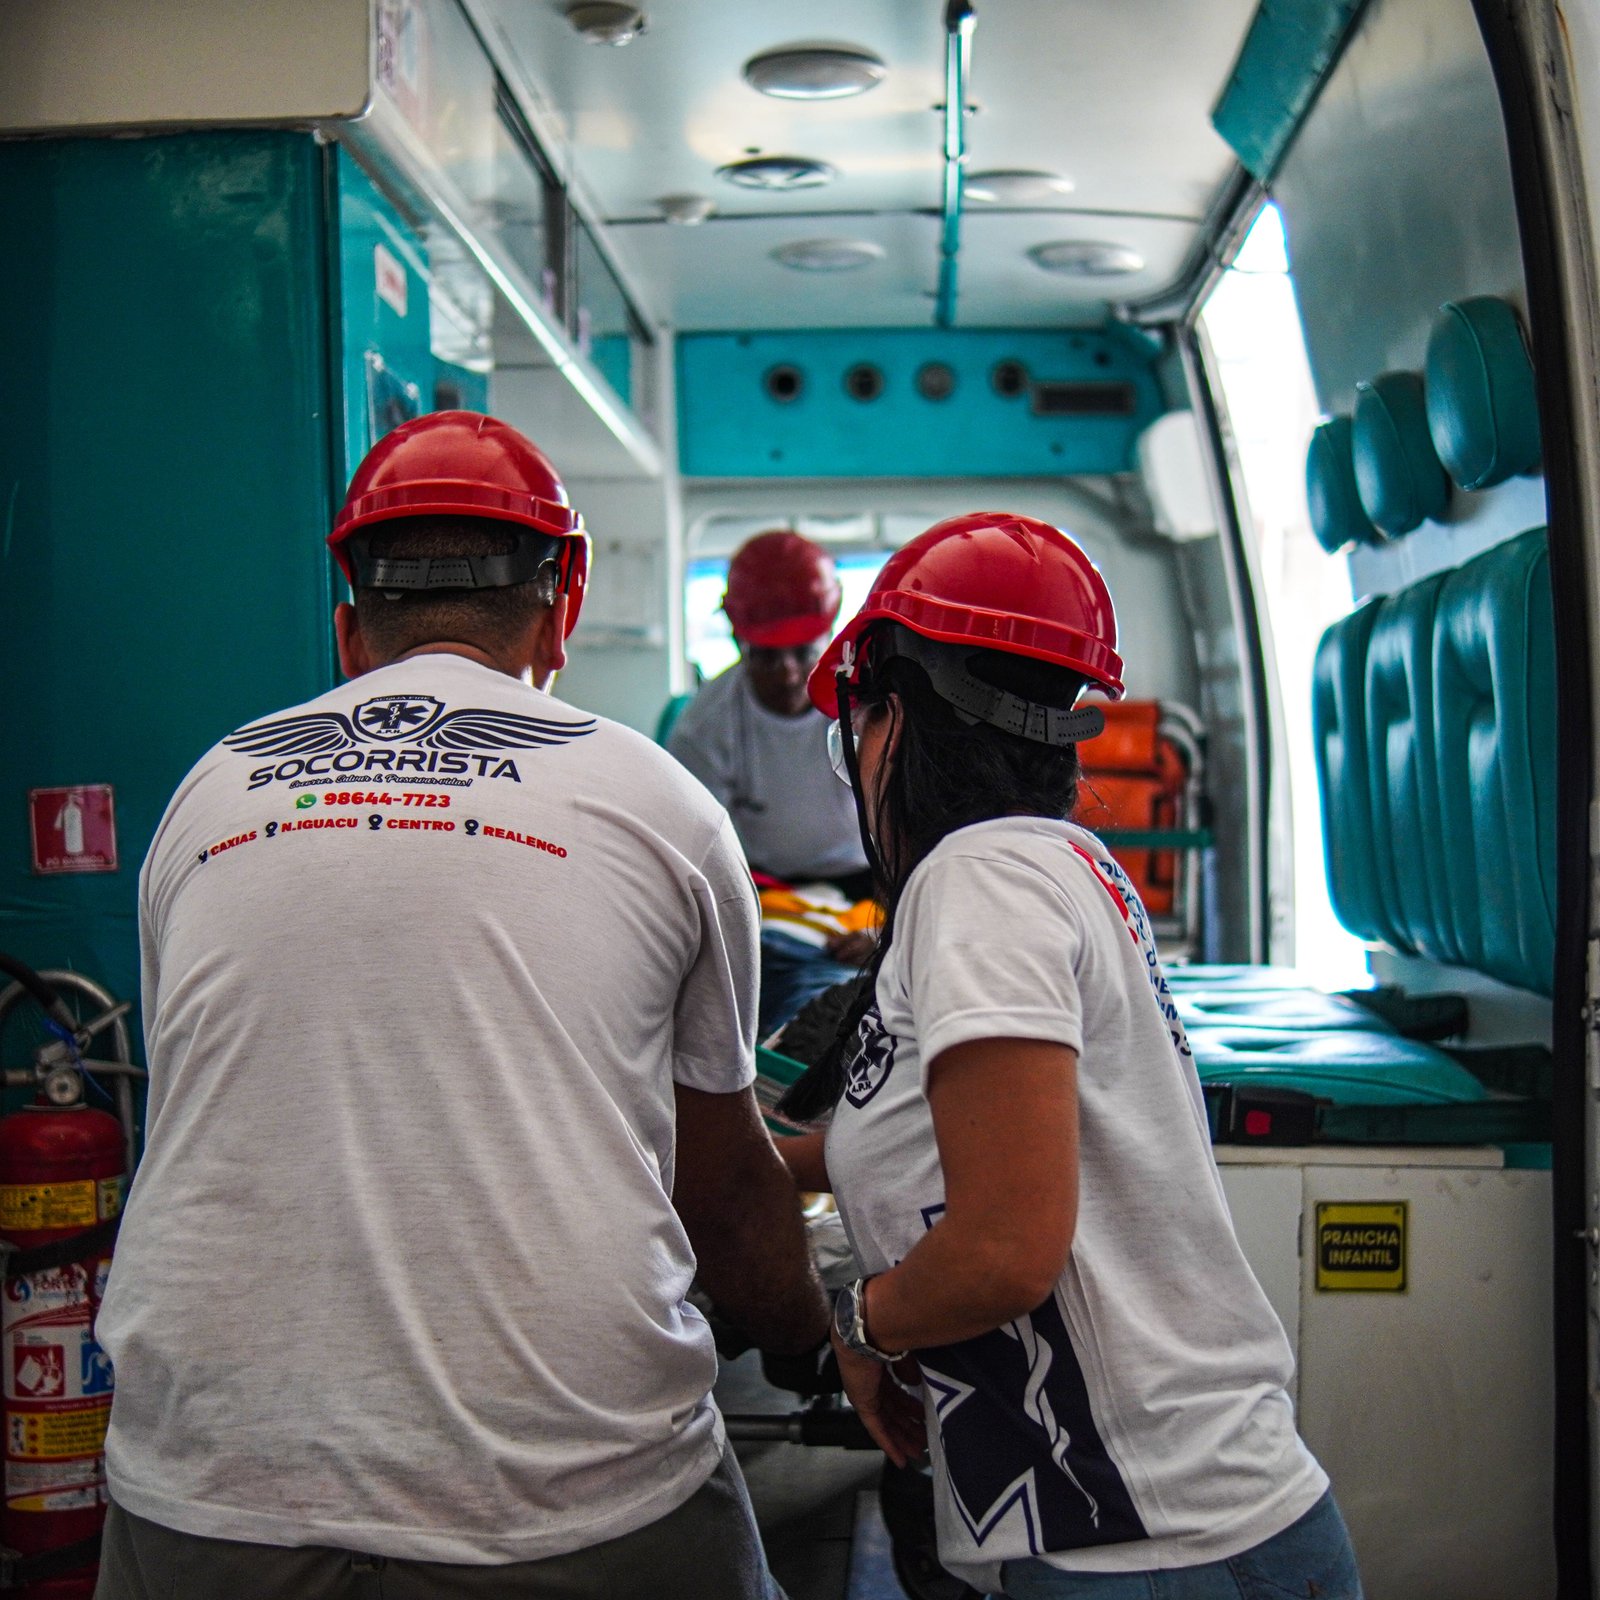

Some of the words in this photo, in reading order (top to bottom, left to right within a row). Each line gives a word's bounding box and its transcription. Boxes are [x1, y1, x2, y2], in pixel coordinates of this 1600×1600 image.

[247, 749, 522, 791] SOCORRISTA
[323, 791, 452, 809] 98644-7723
[210, 831, 257, 856] CAXIAS
[280, 817, 359, 833] N.IGUACU
[385, 818, 456, 832] CENTRO
[482, 825, 568, 859] REALENGO
[1322, 1229, 1399, 1246] PRANCHA
[1328, 1249, 1394, 1265] INFANTIL
